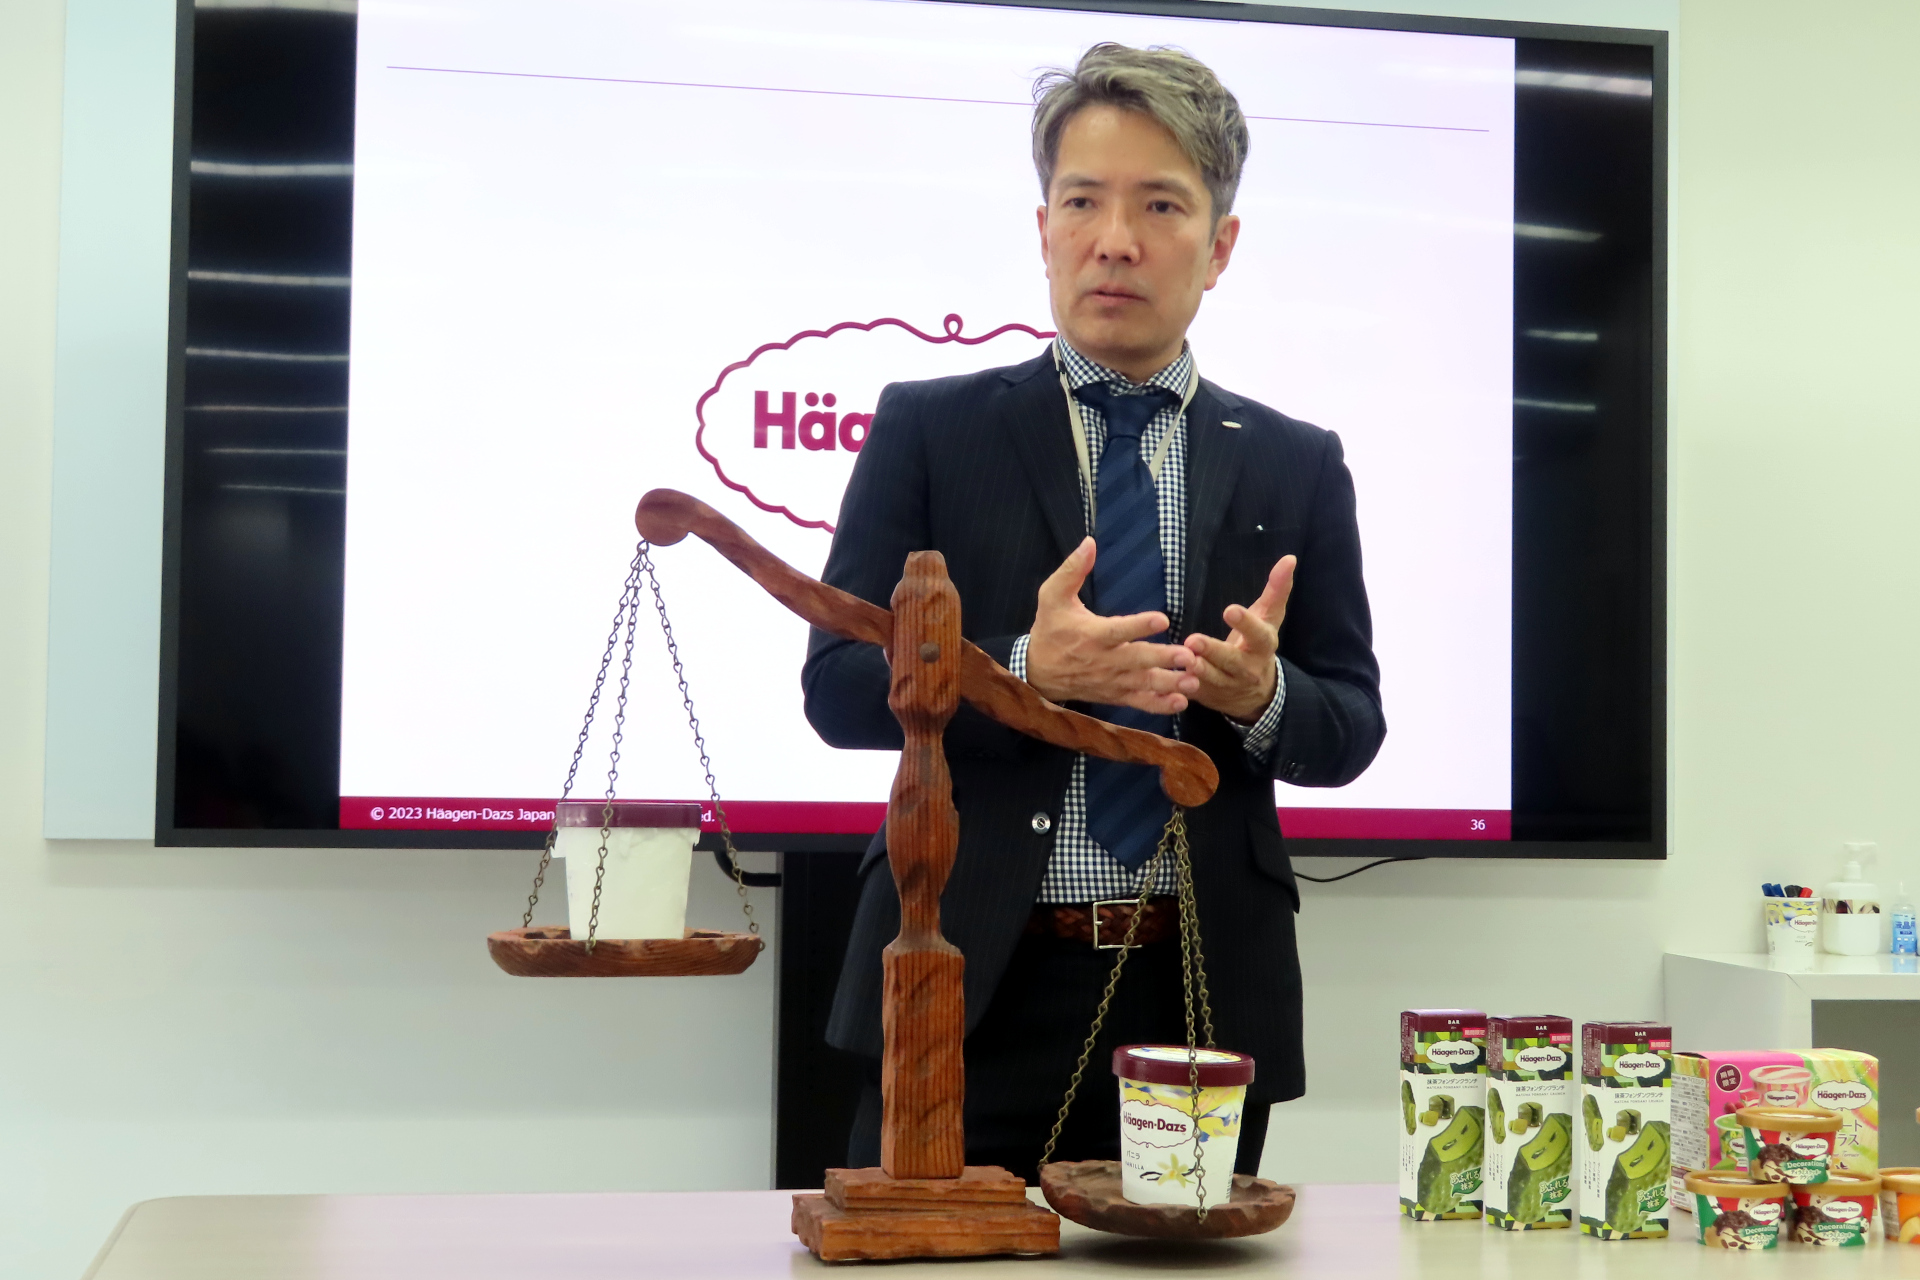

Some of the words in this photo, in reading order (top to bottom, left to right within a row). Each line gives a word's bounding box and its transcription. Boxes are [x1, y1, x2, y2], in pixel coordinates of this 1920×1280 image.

[754, 390, 876, 453] Häa
[388, 806, 423, 820] 2023
[426, 807, 515, 823] Häagen-Dazs
[517, 808, 556, 823] Japan
[1470, 818, 1486, 831] 36
[1431, 1047, 1475, 1058] Häagen-Dazs
[1520, 1054, 1562, 1064] Häagen-Dazs
[1619, 1060, 1661, 1070] Häagen-Dazs
[1817, 1090, 1867, 1101] Häagen-Dazs
[1123, 1110, 1187, 1133] Häagen-Dazs
[1842, 1119, 1863, 1132] ート
[1837, 1133, 1860, 1147] ラス
